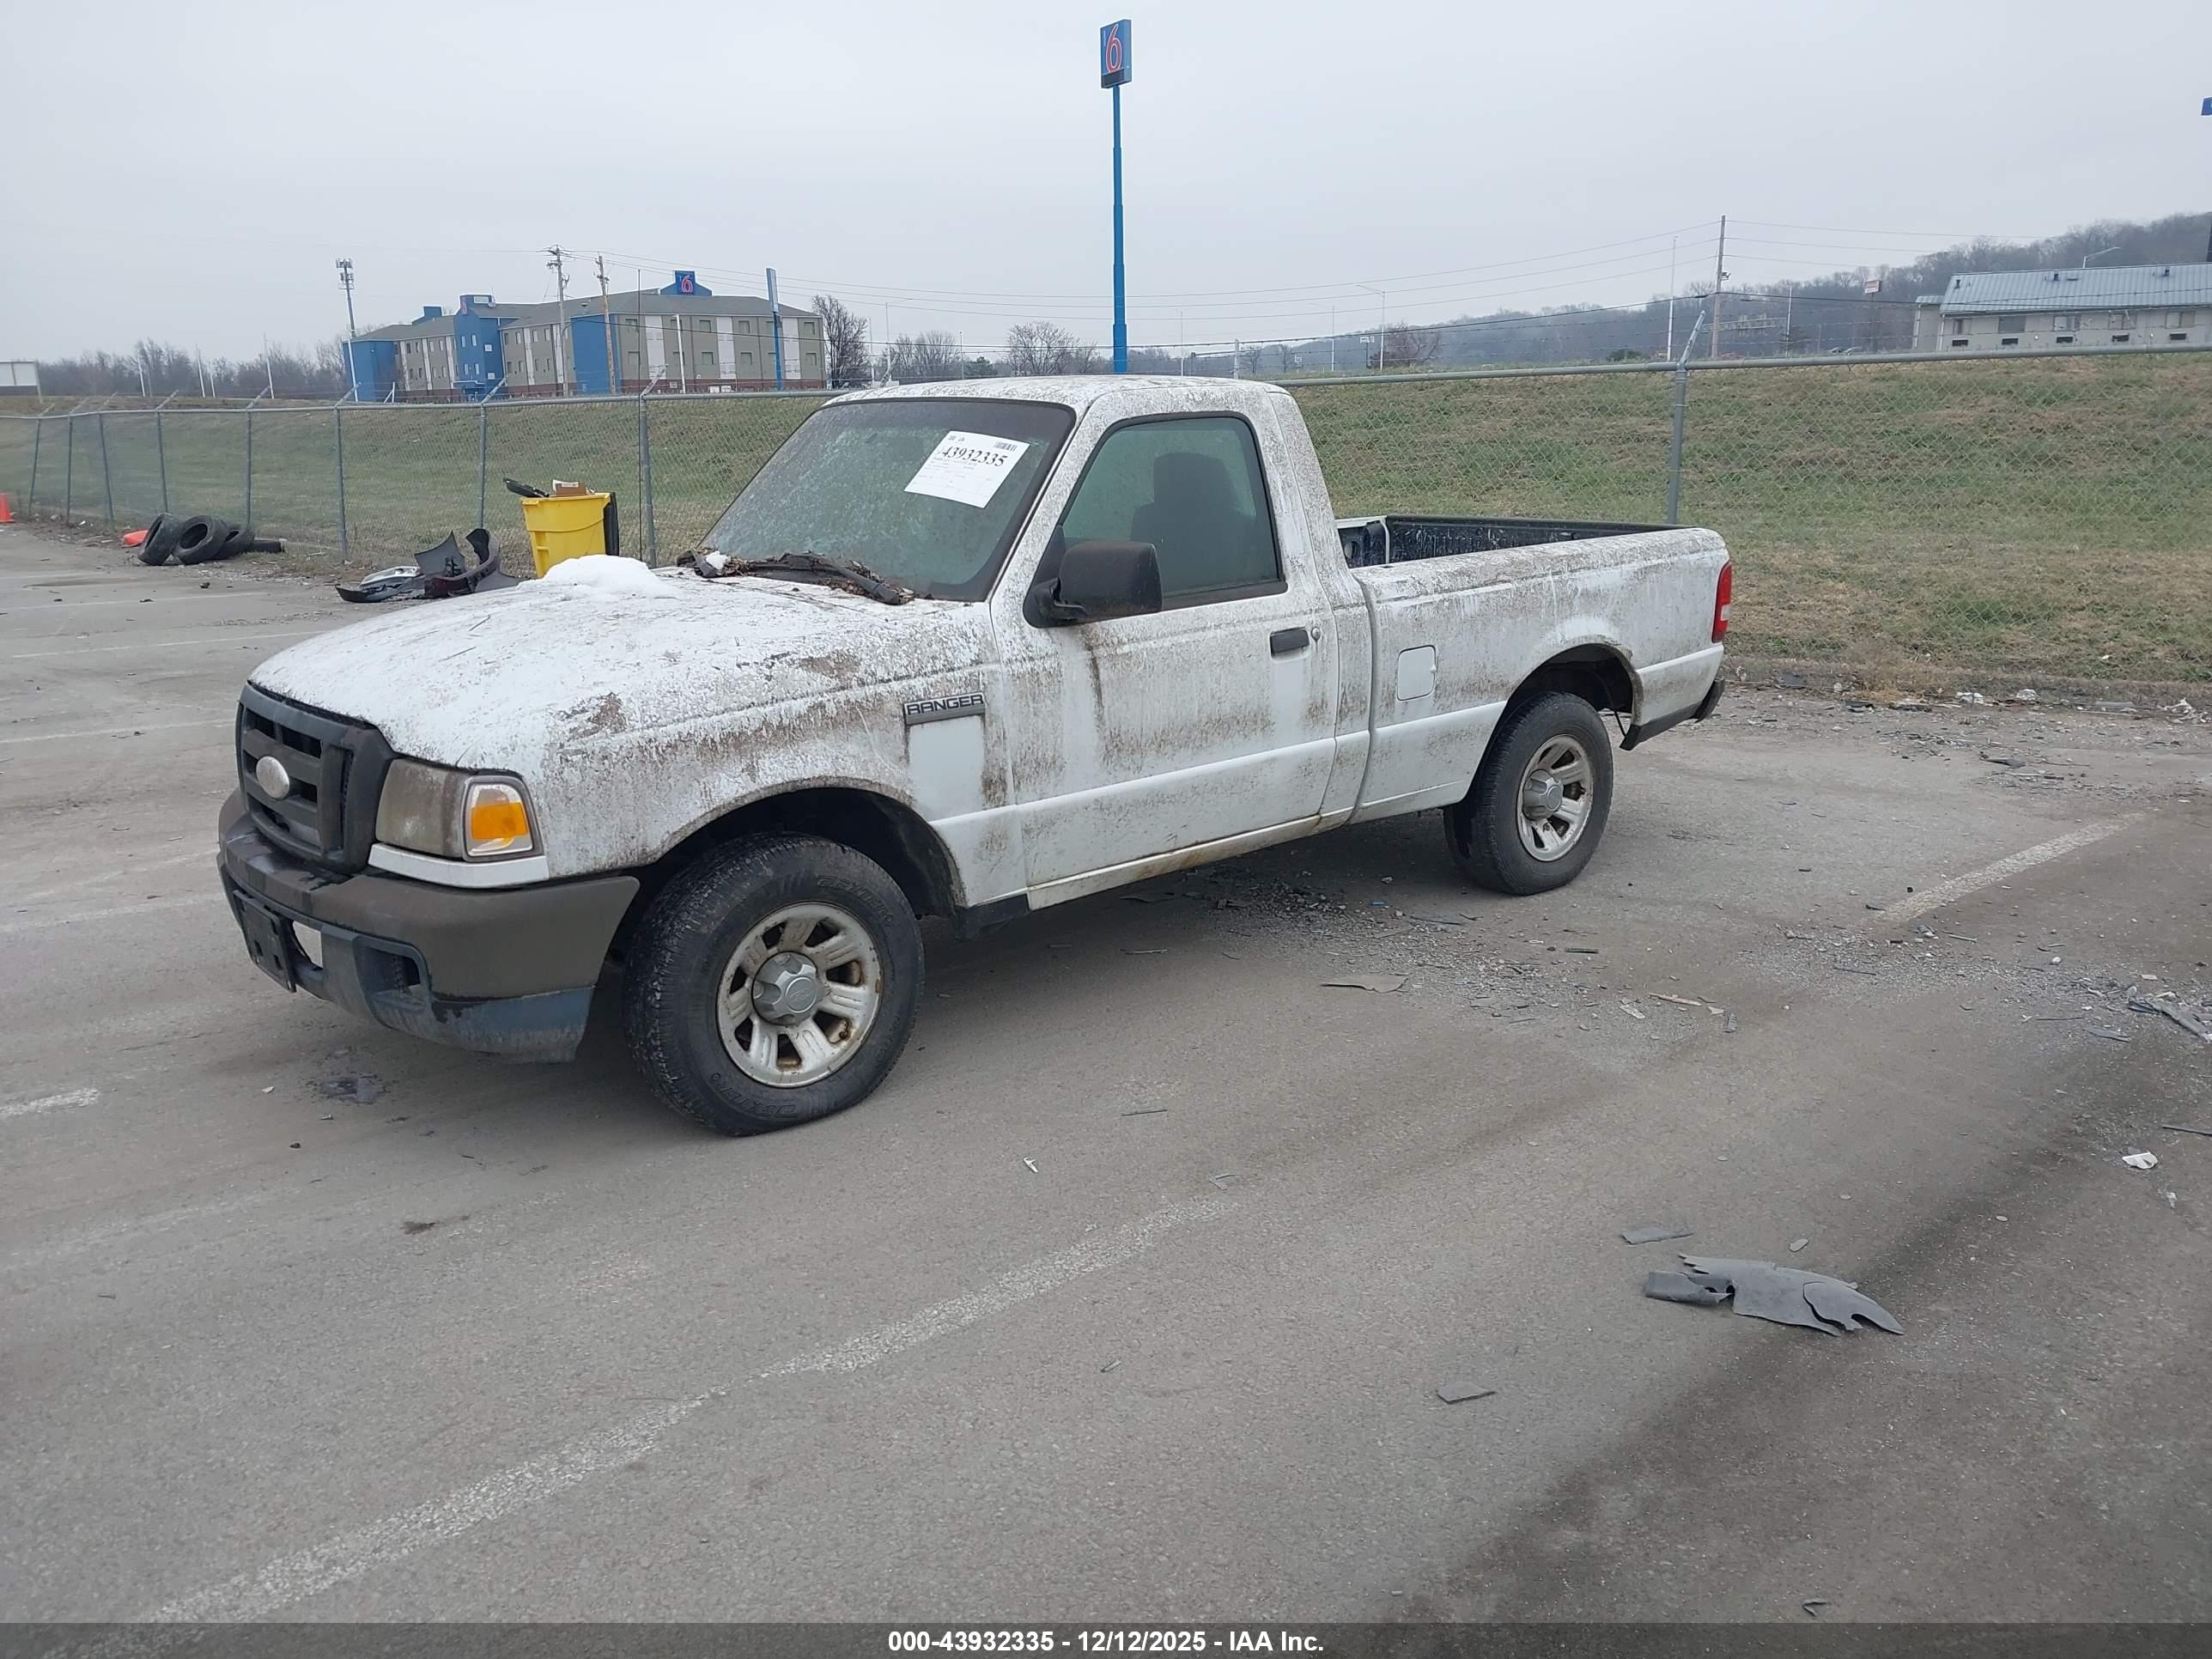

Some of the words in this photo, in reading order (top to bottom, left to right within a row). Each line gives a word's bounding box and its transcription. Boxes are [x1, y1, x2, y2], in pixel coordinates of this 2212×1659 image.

[1106, 23, 1121, 73] 6
[681, 275, 693, 294] 6
[942, 446, 1008, 467] 43932335
[906, 694, 984, 715] RANGER
